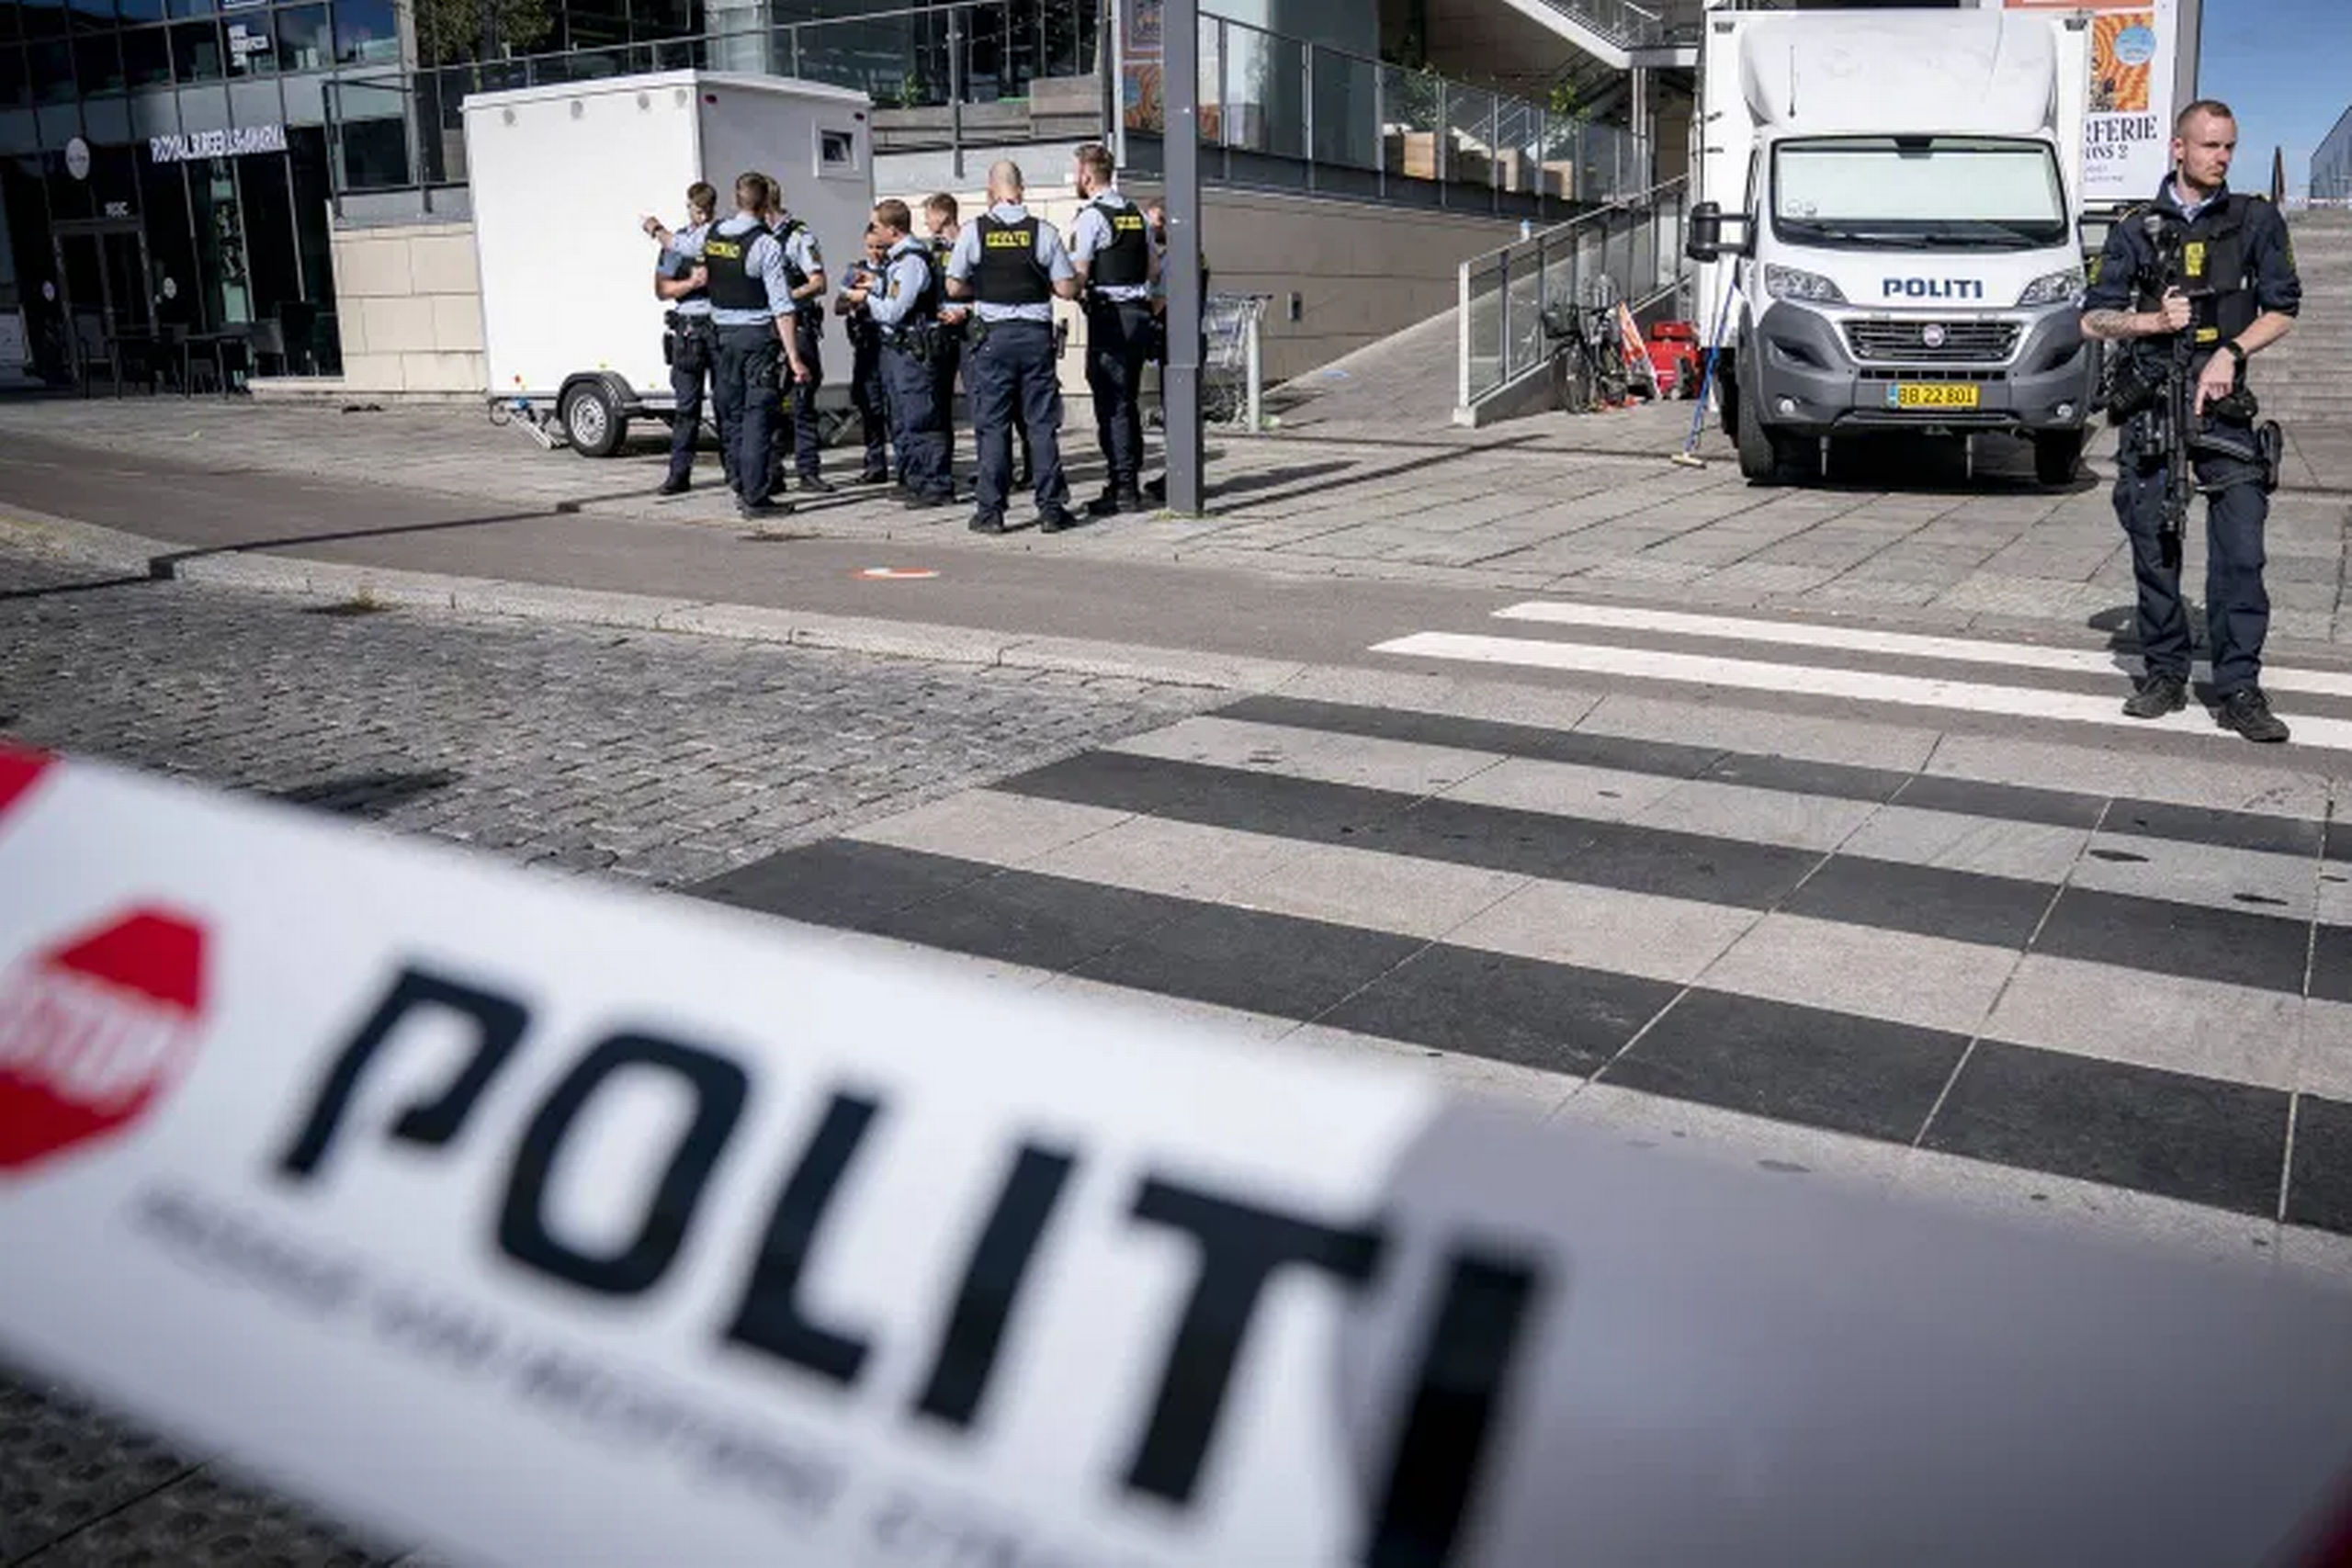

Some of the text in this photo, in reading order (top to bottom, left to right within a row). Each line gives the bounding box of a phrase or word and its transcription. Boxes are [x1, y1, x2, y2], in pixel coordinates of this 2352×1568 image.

[1883, 278, 1983, 299] POLITI
[1923, 387, 1943, 404] 22
[276, 963, 1548, 1568] POLITI
